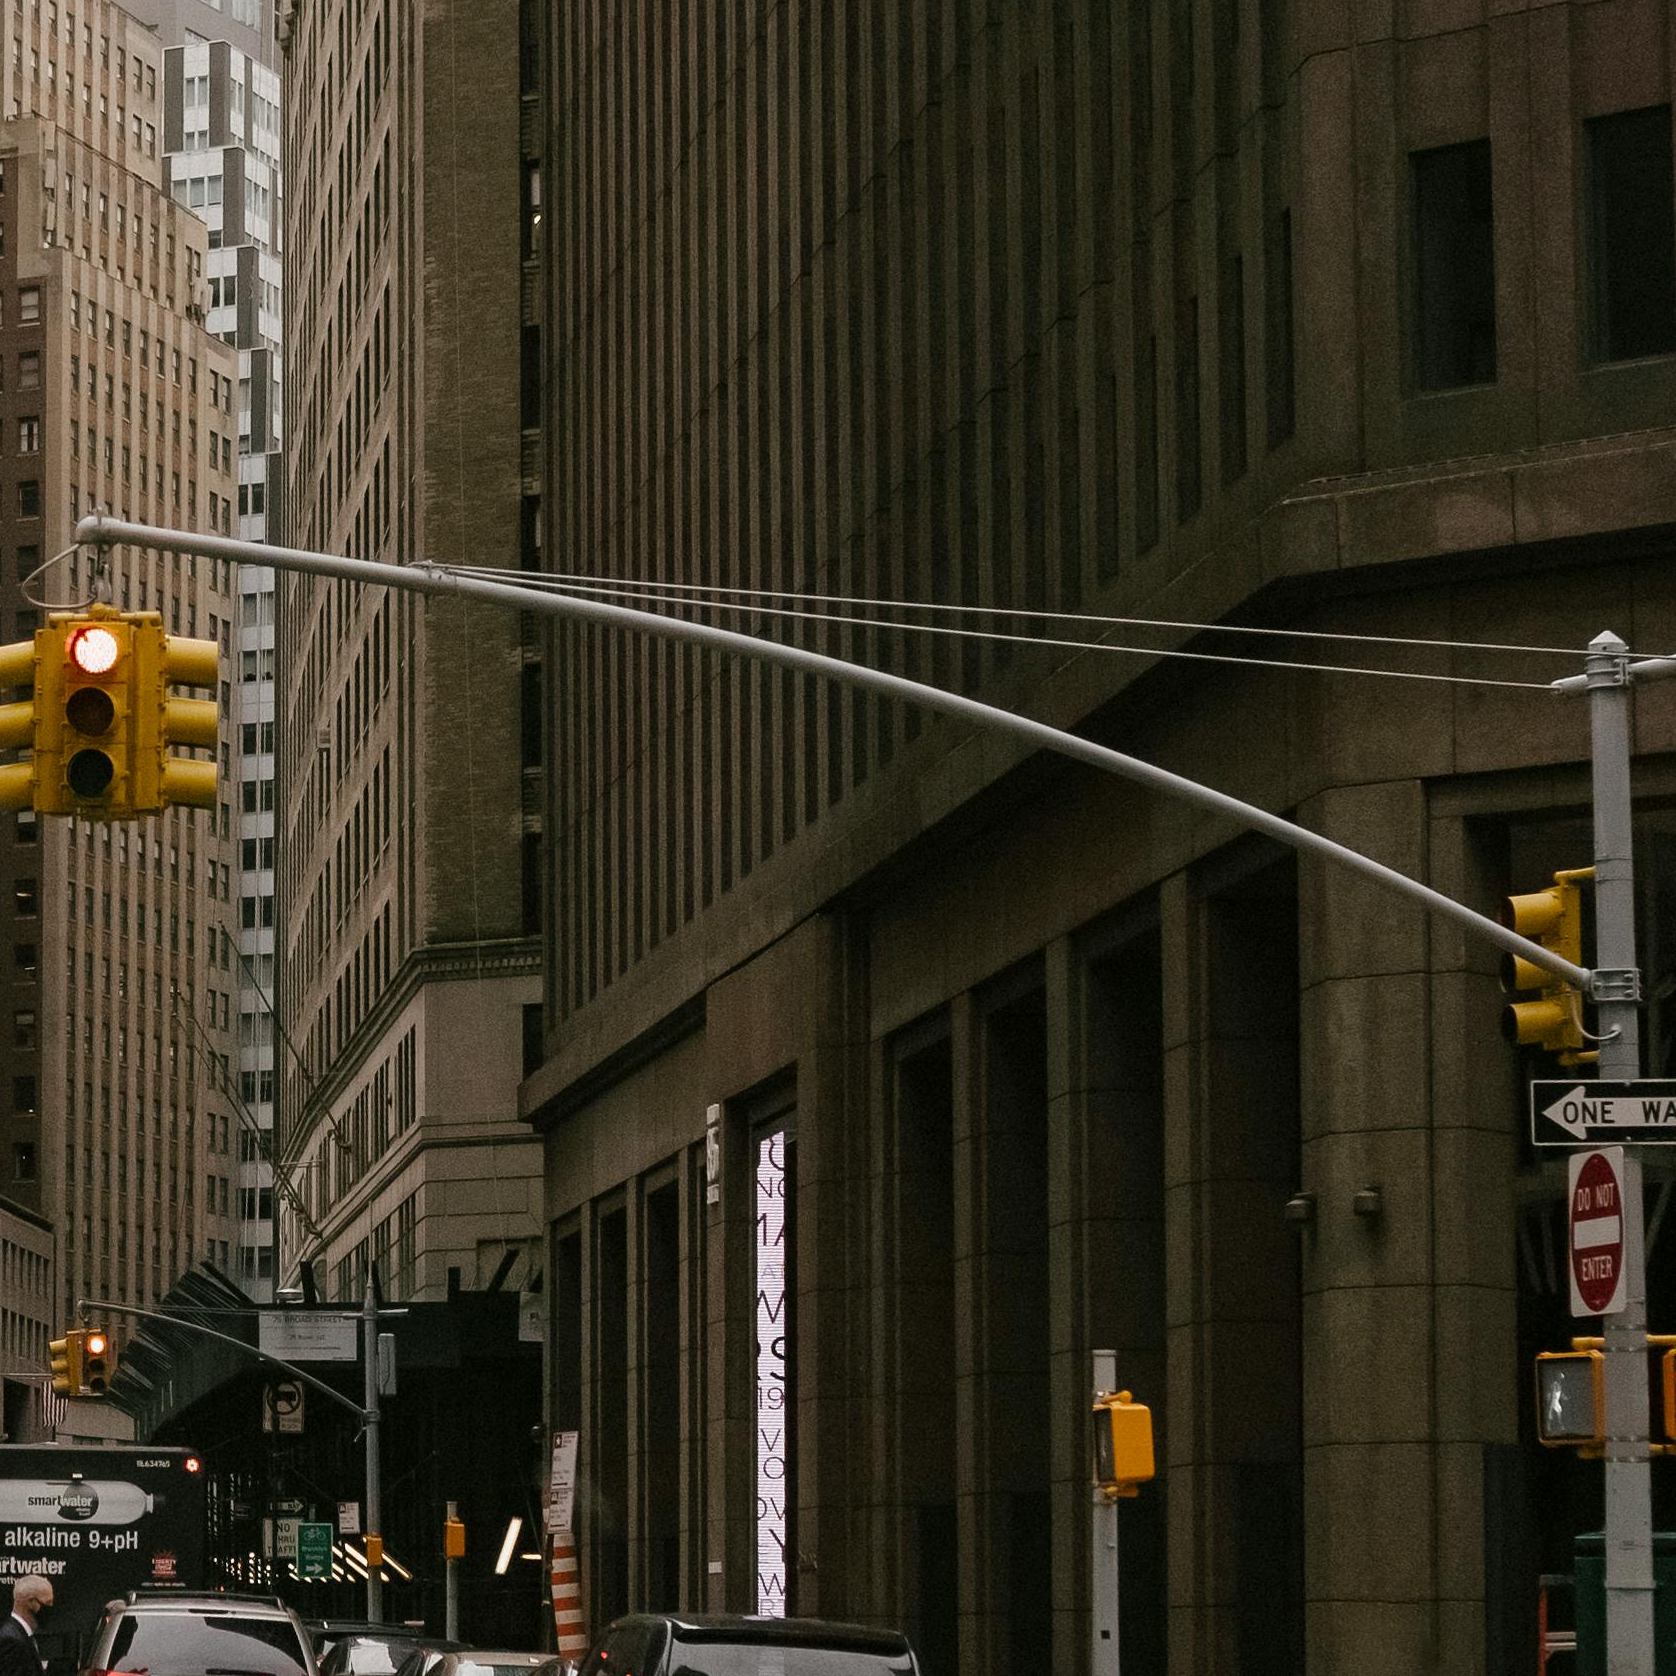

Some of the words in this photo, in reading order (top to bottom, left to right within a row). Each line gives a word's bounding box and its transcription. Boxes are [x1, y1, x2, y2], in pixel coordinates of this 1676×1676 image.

[1563, 1101, 1615, 1124] ONE
[1642, 1101, 1676, 1124] WA
[1577, 1188, 1591, 1212] DO
[1596, 1183, 1615, 1208] NOT
[1581, 1255, 1613, 1282] ENTER
[27, 1494, 93, 1508] smartwater
[5, 1527, 80, 1548] alkaline
[89, 1530, 138, 1553] 9+pH
[277, 1524, 290, 1532] NO
